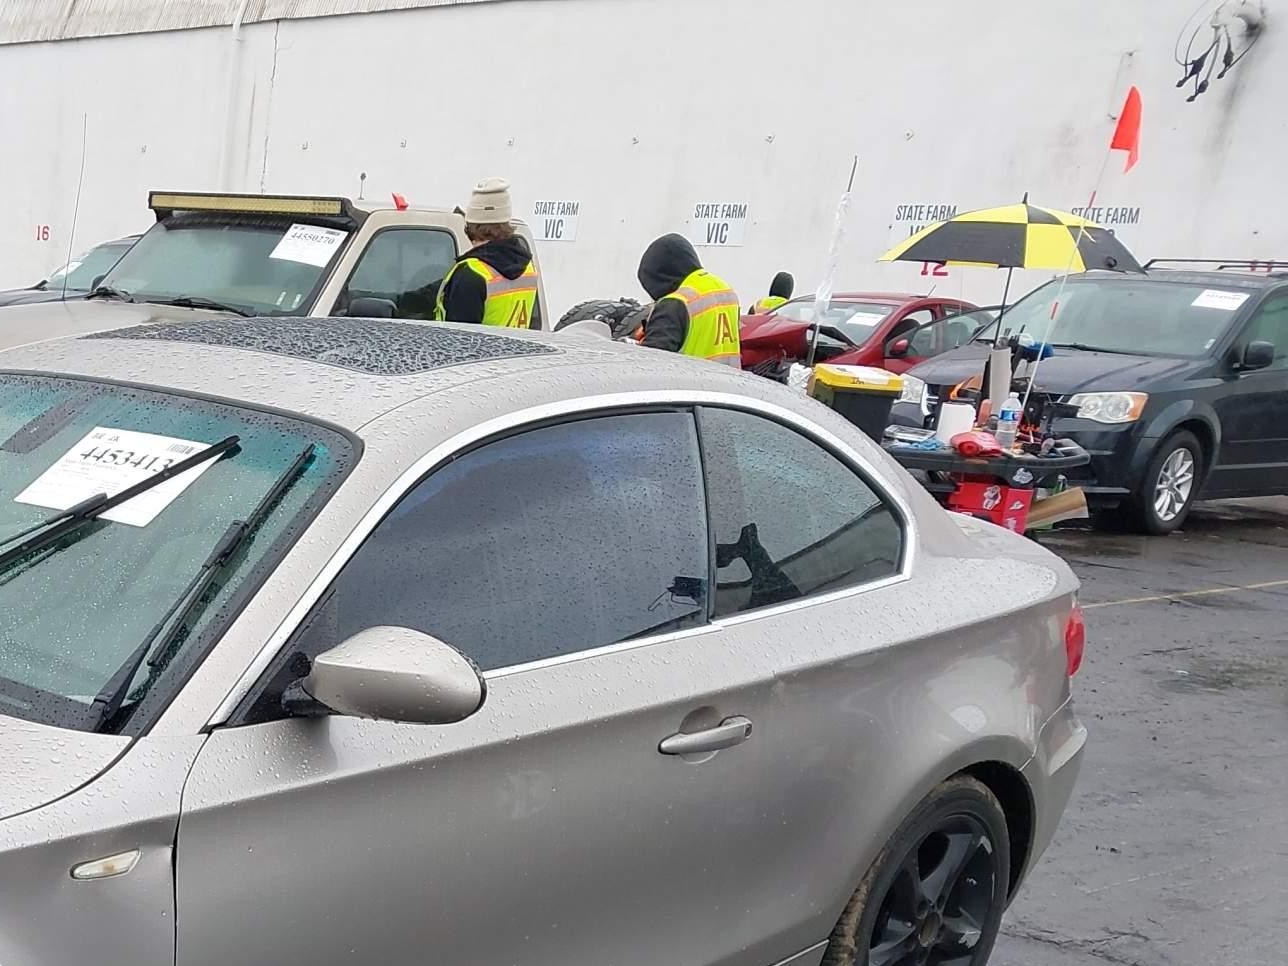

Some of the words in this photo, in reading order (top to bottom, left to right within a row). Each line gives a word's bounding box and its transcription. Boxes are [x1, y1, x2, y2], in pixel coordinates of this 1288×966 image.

[534, 201, 554, 216] STATE
[555, 201, 579, 216] FARM
[694, 203, 720, 219] STATE
[720, 203, 747, 219] FARM
[895, 204, 925, 221] STATE
[925, 204, 957, 221] FARM
[1104, 207, 1141, 225] FARM
[36, 225, 50, 241] 16
[543, 218, 564, 239] VIC
[706, 222, 729, 244] VIC
[79, 445, 175, 474] 4453413
